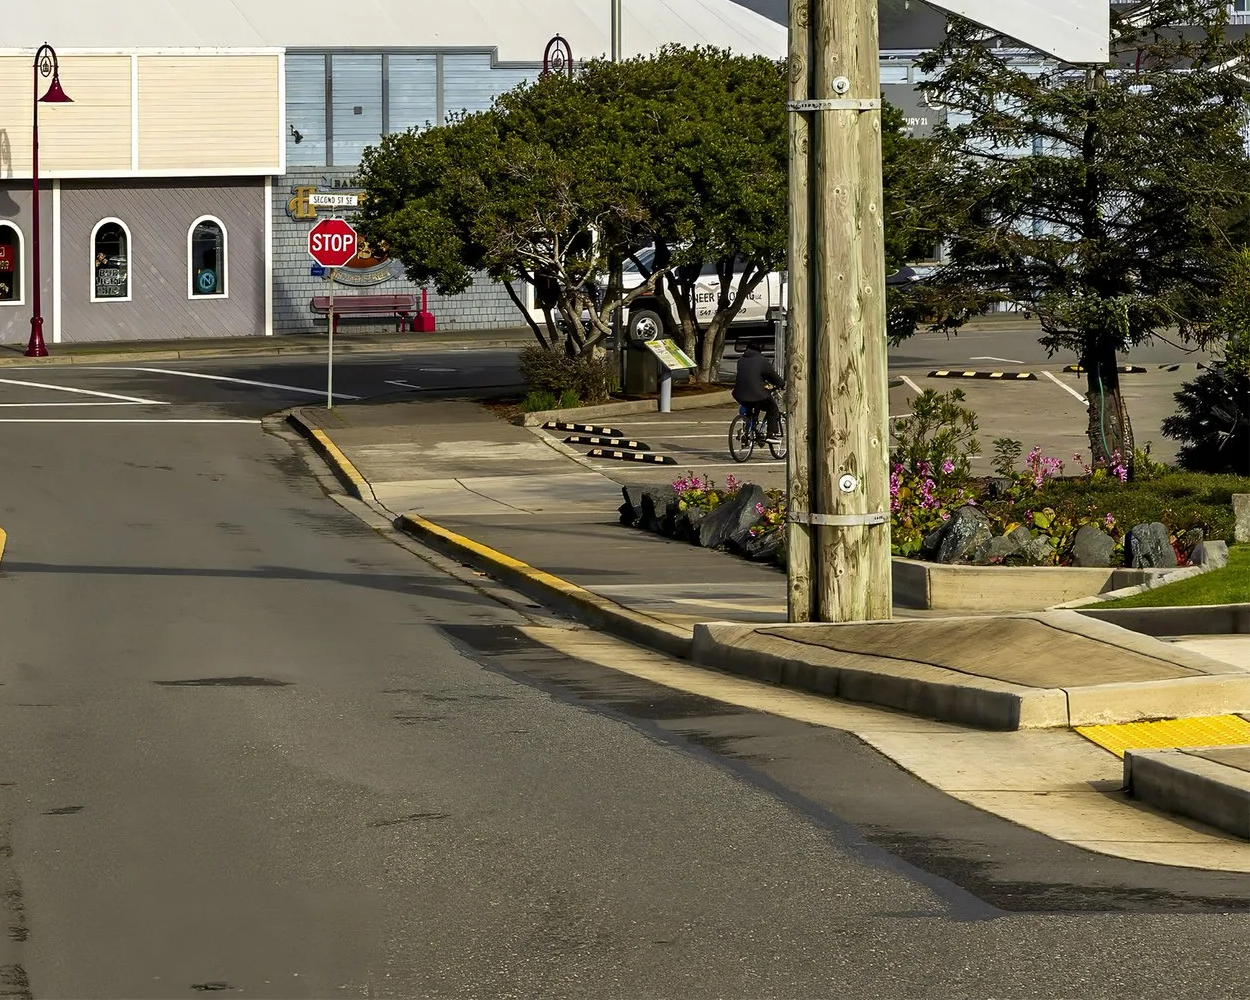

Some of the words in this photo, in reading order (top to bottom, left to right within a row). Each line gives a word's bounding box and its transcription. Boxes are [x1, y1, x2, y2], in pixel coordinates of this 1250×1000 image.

[920, 117, 928, 126] 21
[313, 196, 336, 204] SECOND
[338, 196, 344, 204] ST
[346, 197, 353, 205] SE
[312, 233, 354, 252] STOP
